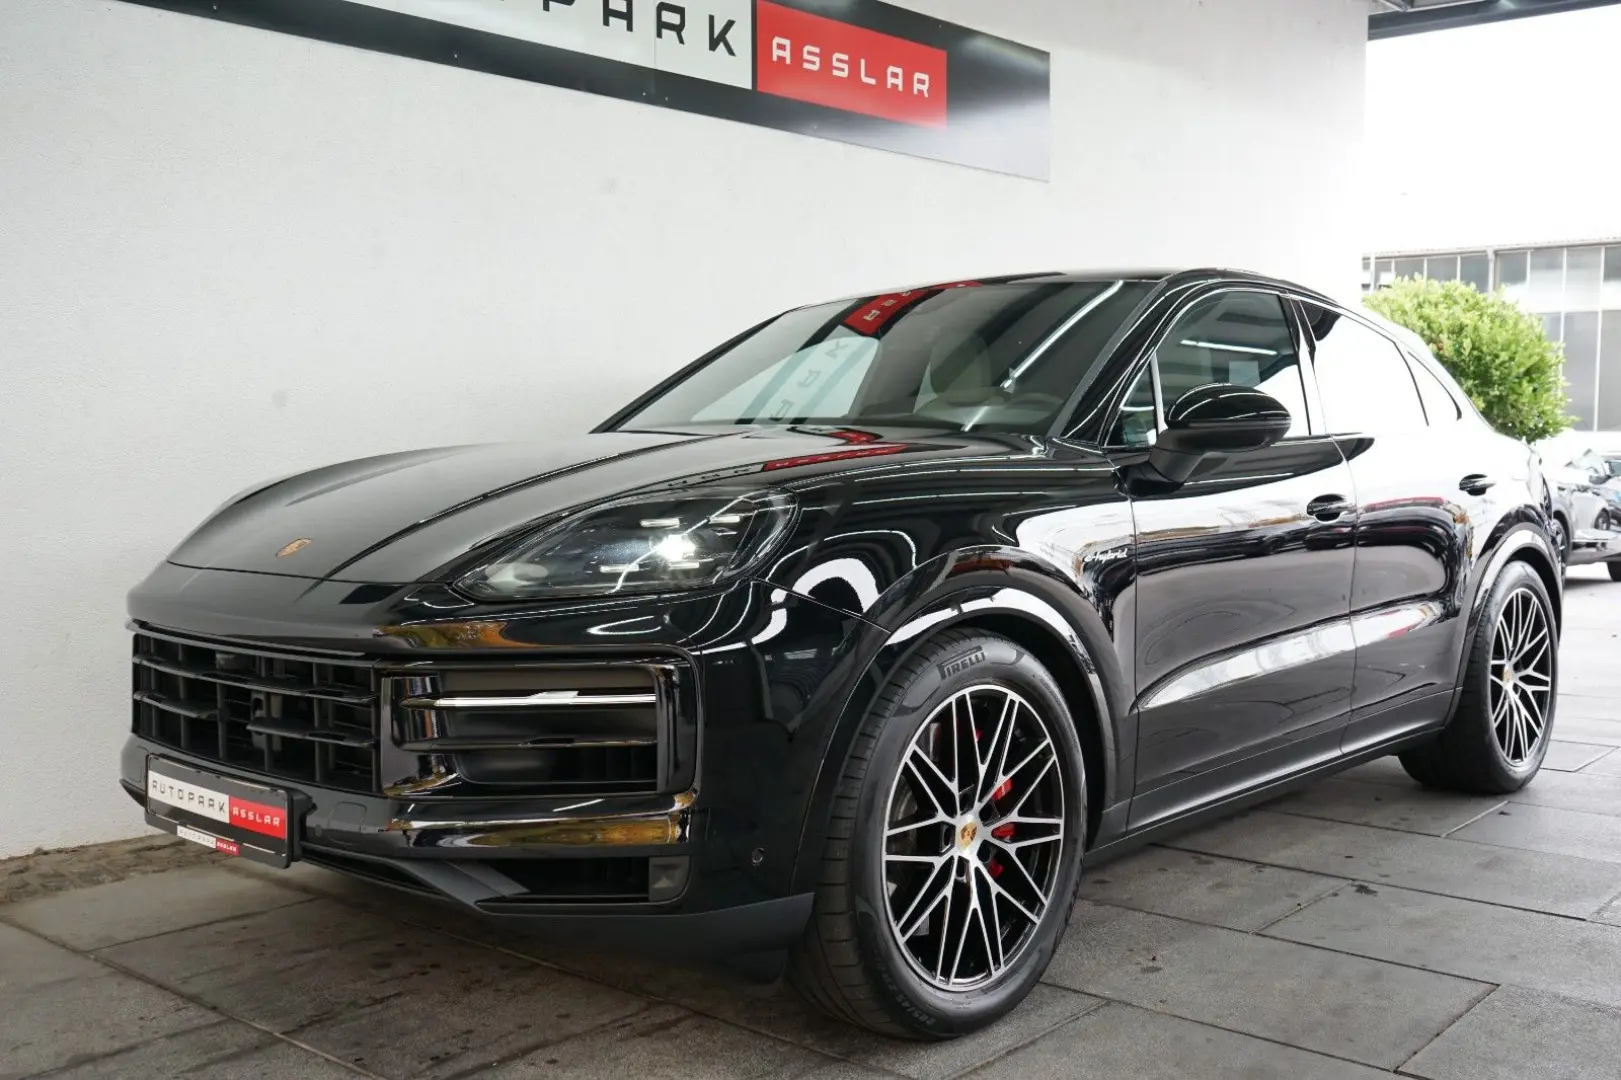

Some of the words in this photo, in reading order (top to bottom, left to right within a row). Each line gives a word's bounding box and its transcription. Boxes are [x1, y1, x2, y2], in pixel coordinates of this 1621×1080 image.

[542, 0, 737, 57] ARK
[772, 35, 930, 98] ASSLAR
[936, 645, 986, 680] PIRELLI
[152, 780, 227, 814] AUTOPARK
[232, 807, 281, 827] ASSLAR
